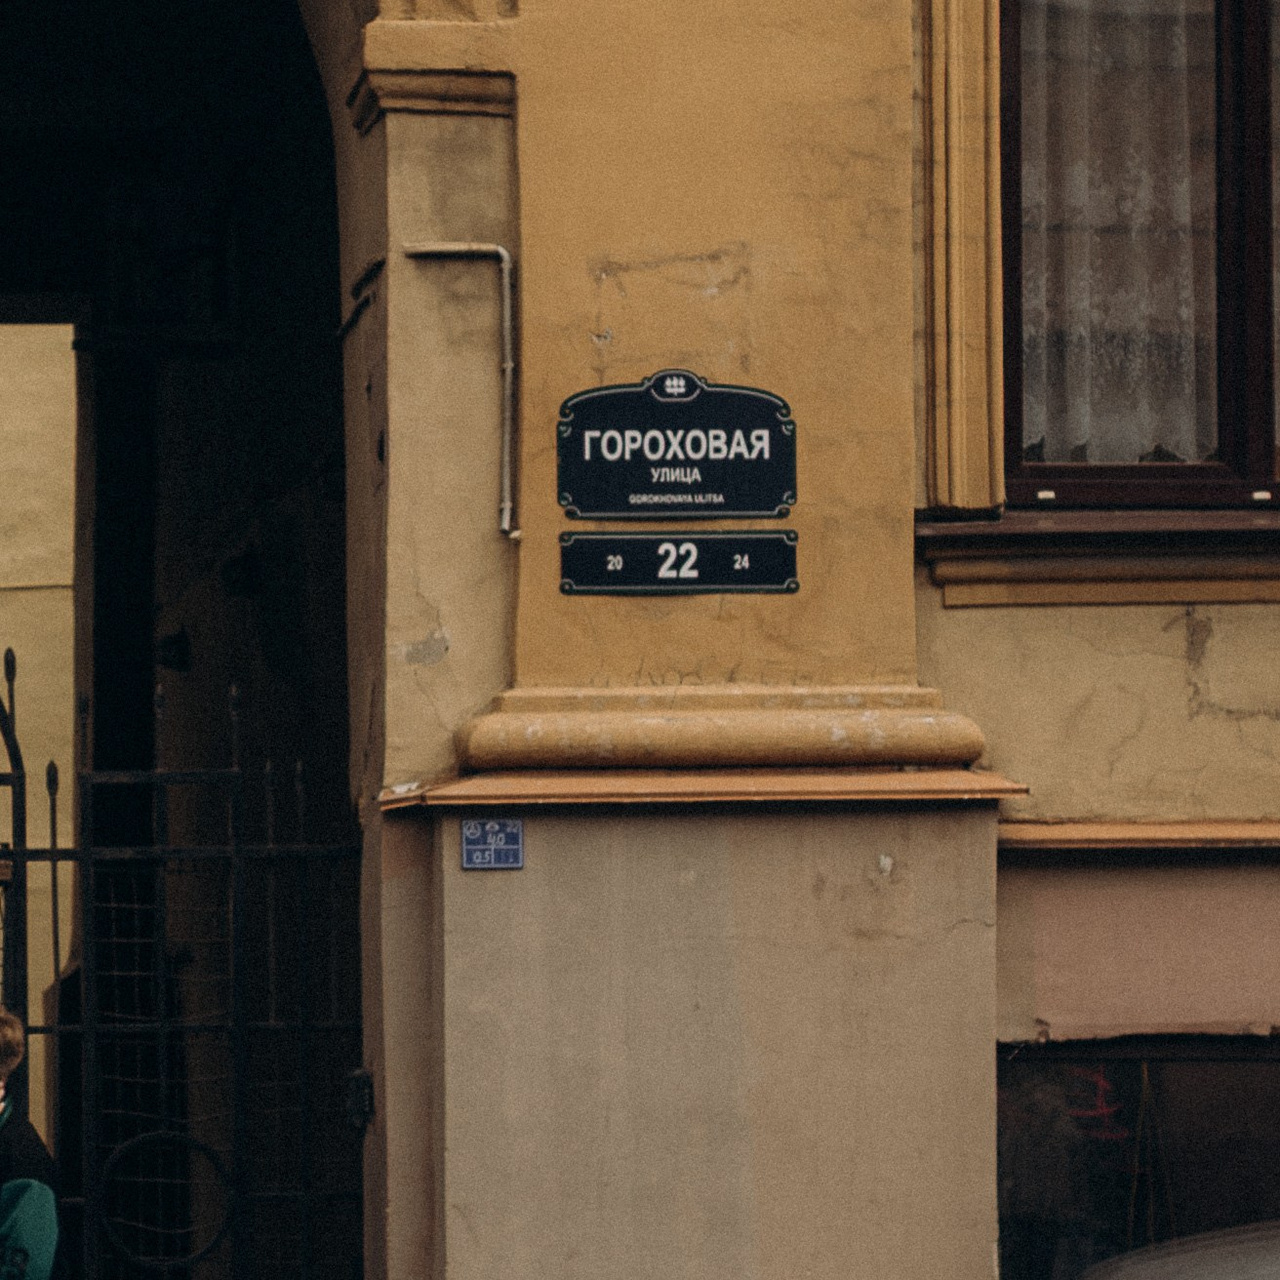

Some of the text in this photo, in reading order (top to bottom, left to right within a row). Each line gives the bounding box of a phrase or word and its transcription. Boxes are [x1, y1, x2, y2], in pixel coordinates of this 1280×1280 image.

[583, 429, 770, 461] ГОРОХОВАЯ
[650, 467, 702, 484] УЛИЦА
[694, 493, 725, 505] ULITSA
[606, 542, 750, 579] 20 22 24
